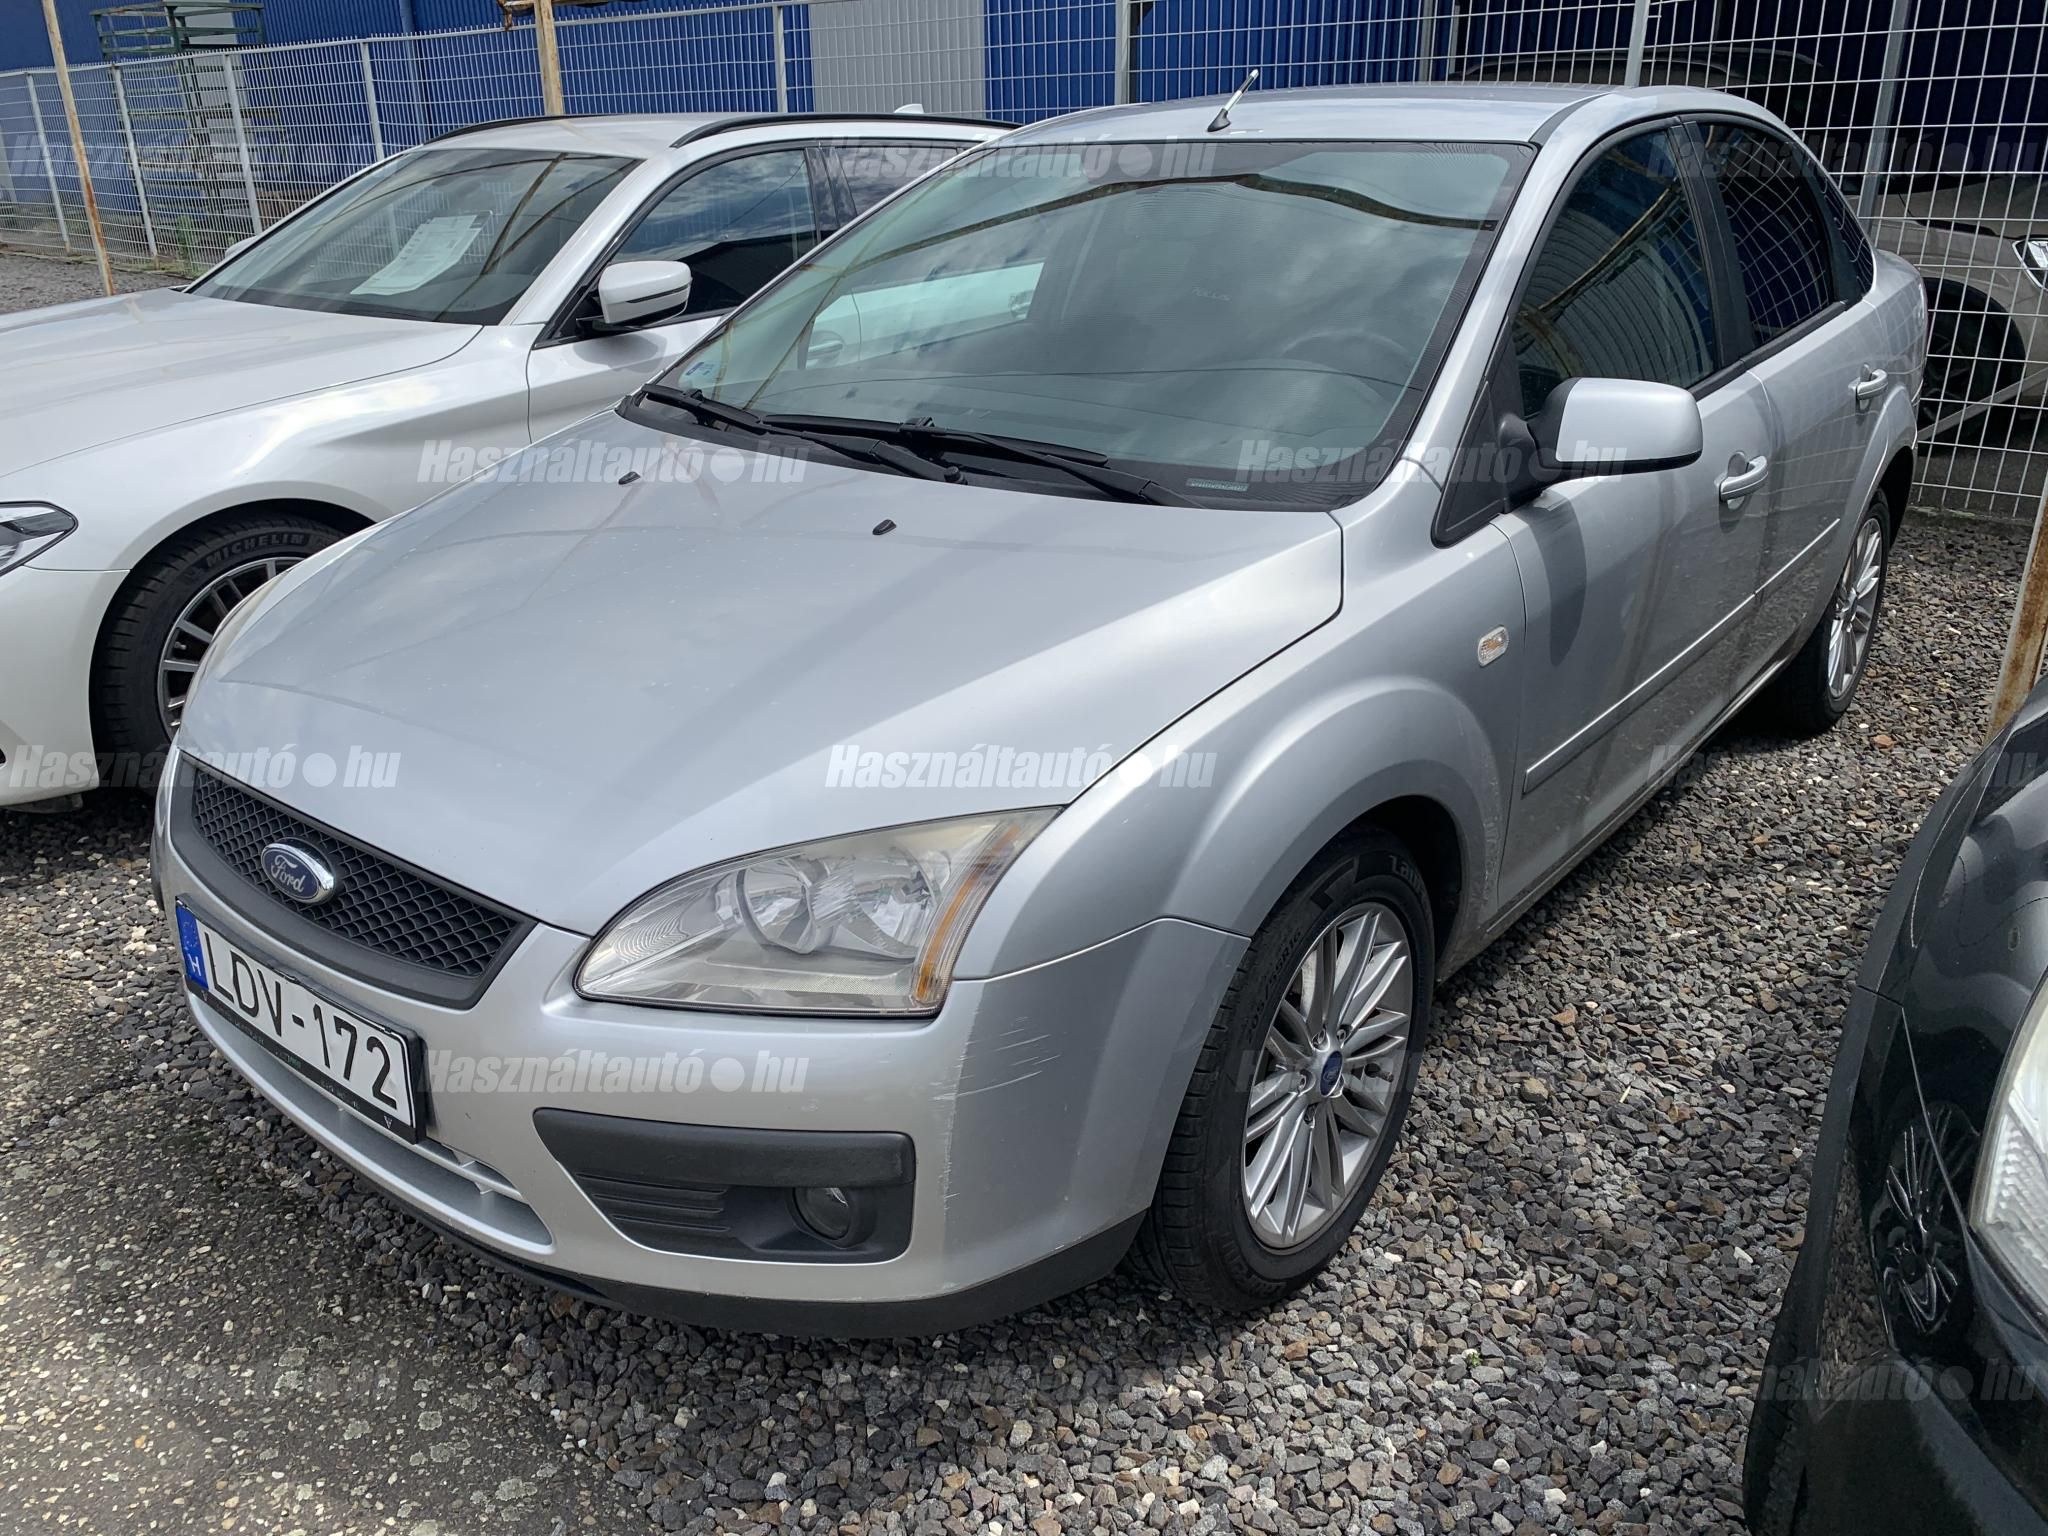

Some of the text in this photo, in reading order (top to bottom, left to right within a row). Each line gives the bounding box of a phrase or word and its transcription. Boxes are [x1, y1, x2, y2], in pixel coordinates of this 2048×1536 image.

[206, 533, 305, 568] MICHELIN
[270, 854, 307, 893] Ford
[186, 955, 202, 977] H
[204, 931, 398, 1110] LDV-172
